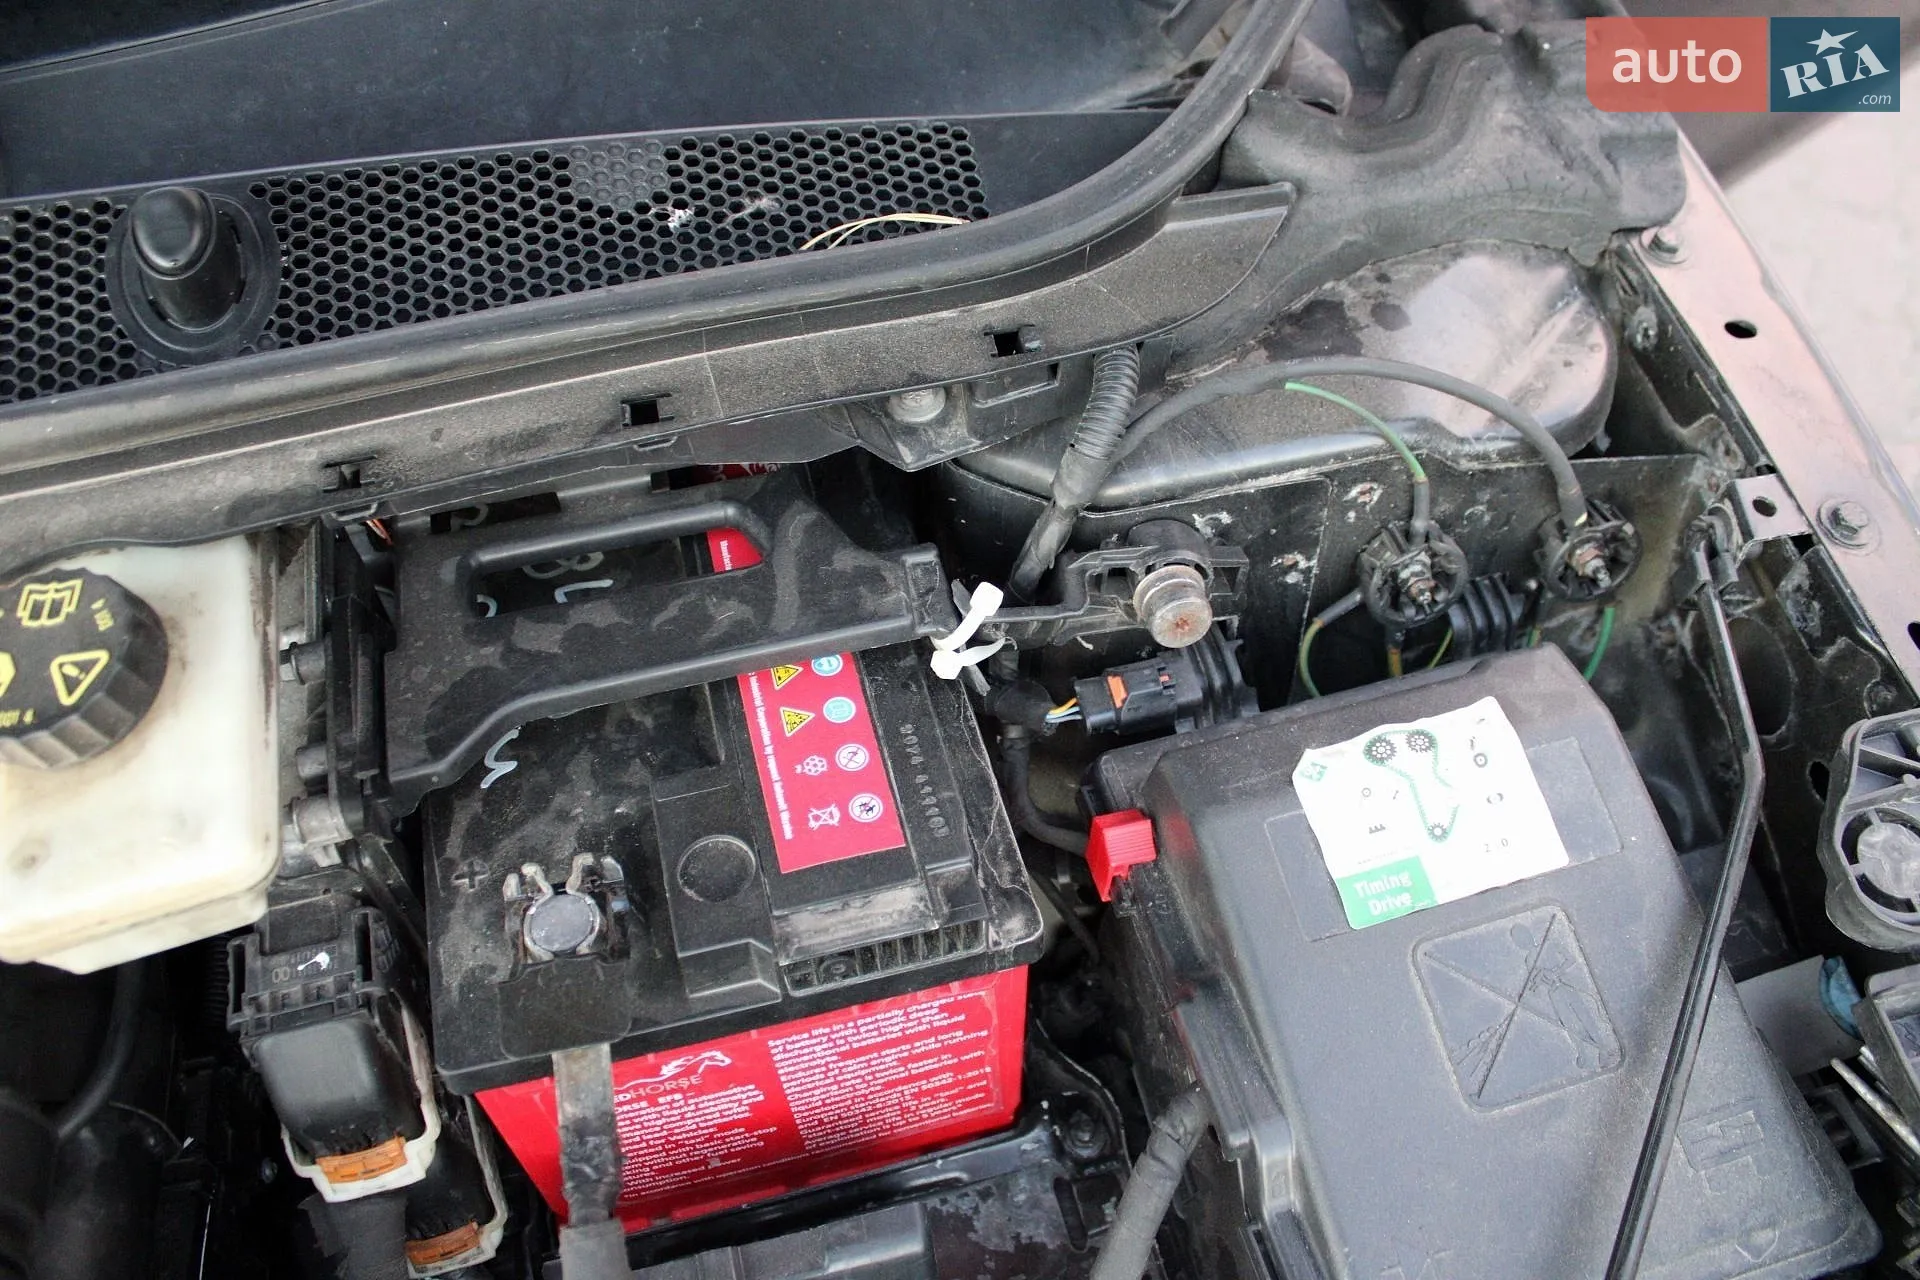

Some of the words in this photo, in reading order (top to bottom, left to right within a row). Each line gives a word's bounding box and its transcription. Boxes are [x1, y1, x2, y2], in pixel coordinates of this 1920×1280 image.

[1353, 869, 1412, 897] Timing
[1368, 891, 1412, 916] Drive
[766, 1031, 809, 1047] Service
[810, 1025, 831, 1036] life
[856, 1007, 905, 1026] partially
[772, 1040, 835, 1062] discharges
[846, 1029, 879, 1042] twice
[880, 1019, 919, 1035] higher
[919, 1011, 948, 1024] than
[784, 1034, 829, 1051] battery
[828, 1027, 857, 1039] with
[858, 1014, 907, 1033] periodic
[908, 1006, 939, 1021] deep
[851, 1030, 902, 1048] batteries
[904, 1023, 931, 1035] with
[933, 1014, 965, 1029] liquid
[779, 1065, 827, 1082] Endures
[827, 1051, 879, 1071] frequent
[913, 1037, 935, 1048] and
[936, 1029, 963, 1043] long
[781, 1072, 825, 1089] periods
[869, 1050, 909, 1067] engine
[910, 1041, 941, 1055] while
[943, 1029, 988, 1048] running
[786, 1082, 839, 1102] Charging
[838, 1076, 863, 1087] rate
[873, 1065, 905, 1078] twice
[788, 1085, 853, 1108] comparison
[868, 1071, 908, 1086] normal
[910, 1057, 958, 1075] batteries
[959, 1050, 985, 1062] with
[793, 1099, 852, 1120] Developed
[866, 1079, 927, 1099] accordance
[928, 1072, 953, 1083] with
[632, 1112, 660, 1123] with
[661, 1103, 696, 1117] liquid
[643, 1113, 681, 1128] higher
[740, 1094, 764, 1105] and
[791, 1100, 823, 1113] liquid
[795, 1106, 848, 1125] European
[903, 1086, 919, 1095] EN
[863, 1104, 900, 1118] service
[901, 1099, 918, 1107] life
[966, 1080, 986, 1090] and
[797, 1119, 819, 1130] and
[822, 1114, 838, 1123] EN
[626, 1145, 662, 1157] erated
[713, 1126, 745, 1138] mode
[626, 1150, 667, 1165] uipped
[668, 1144, 694, 1155] with
[643, 1151, 687, 1166] without
[651, 1160, 672, 1170] and
[674, 1153, 704, 1165] other
[706, 1148, 728, 1158] fuel
[729, 1139, 765, 1153] saving
